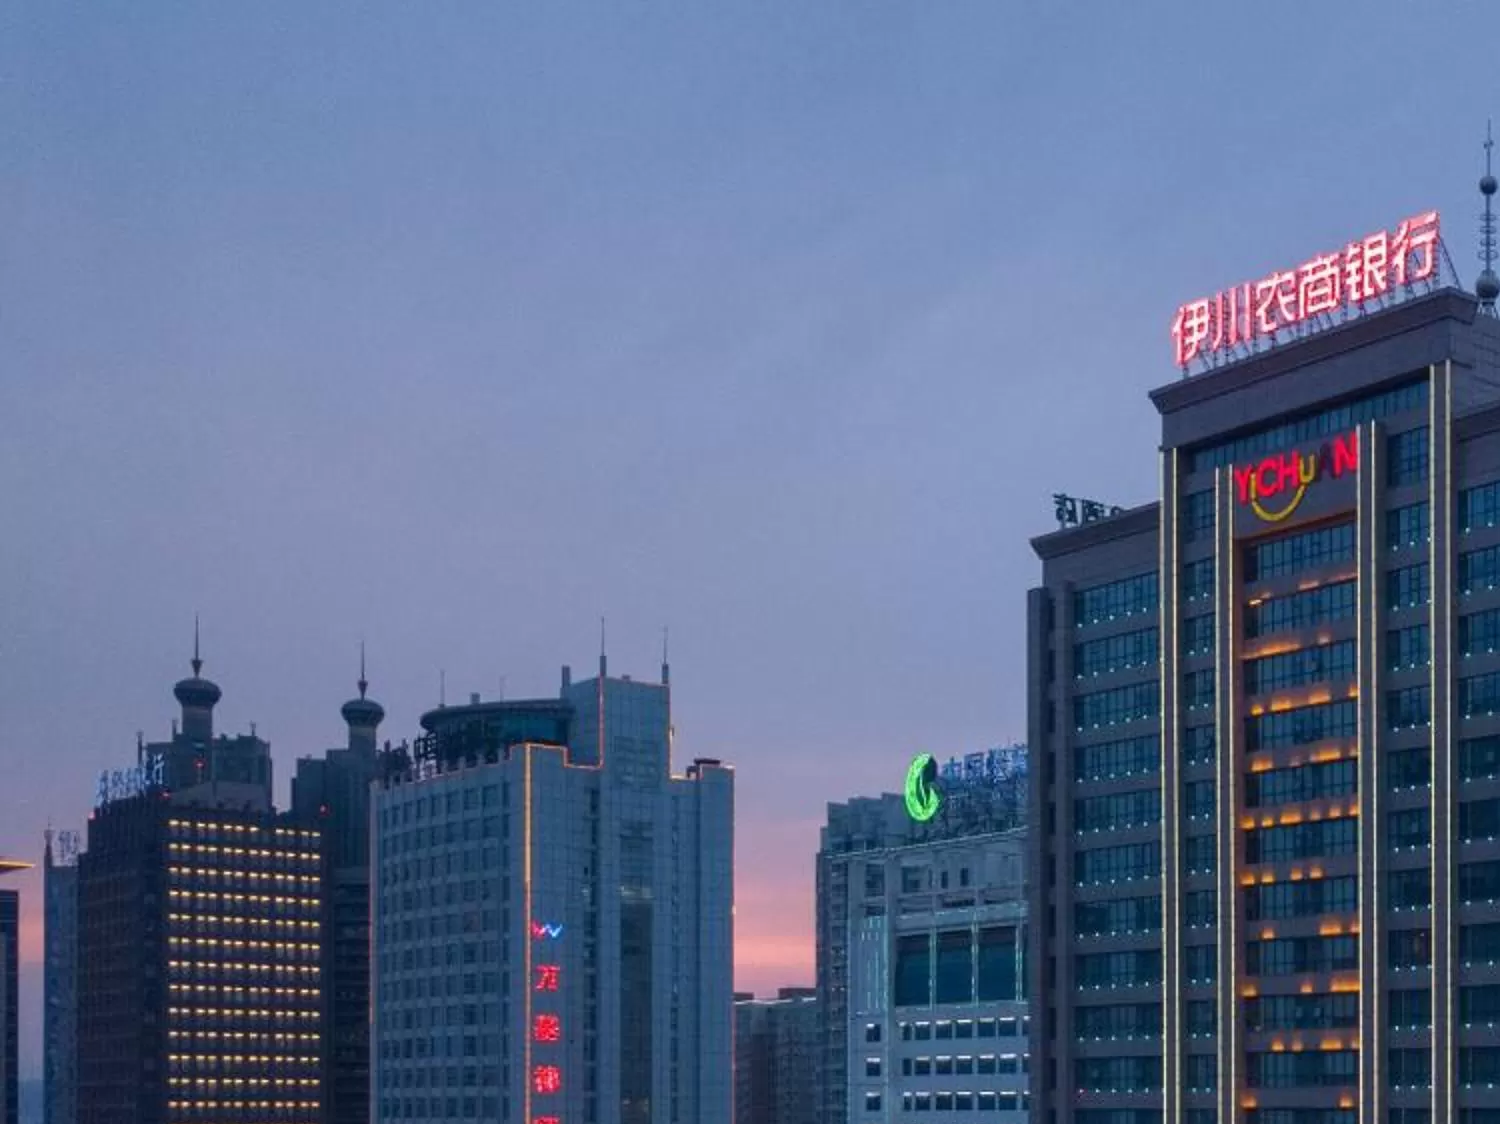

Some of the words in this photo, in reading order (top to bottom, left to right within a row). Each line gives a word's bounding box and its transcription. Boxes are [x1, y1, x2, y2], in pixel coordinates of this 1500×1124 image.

[1171, 211, 1440, 365] 伊川农商银行
